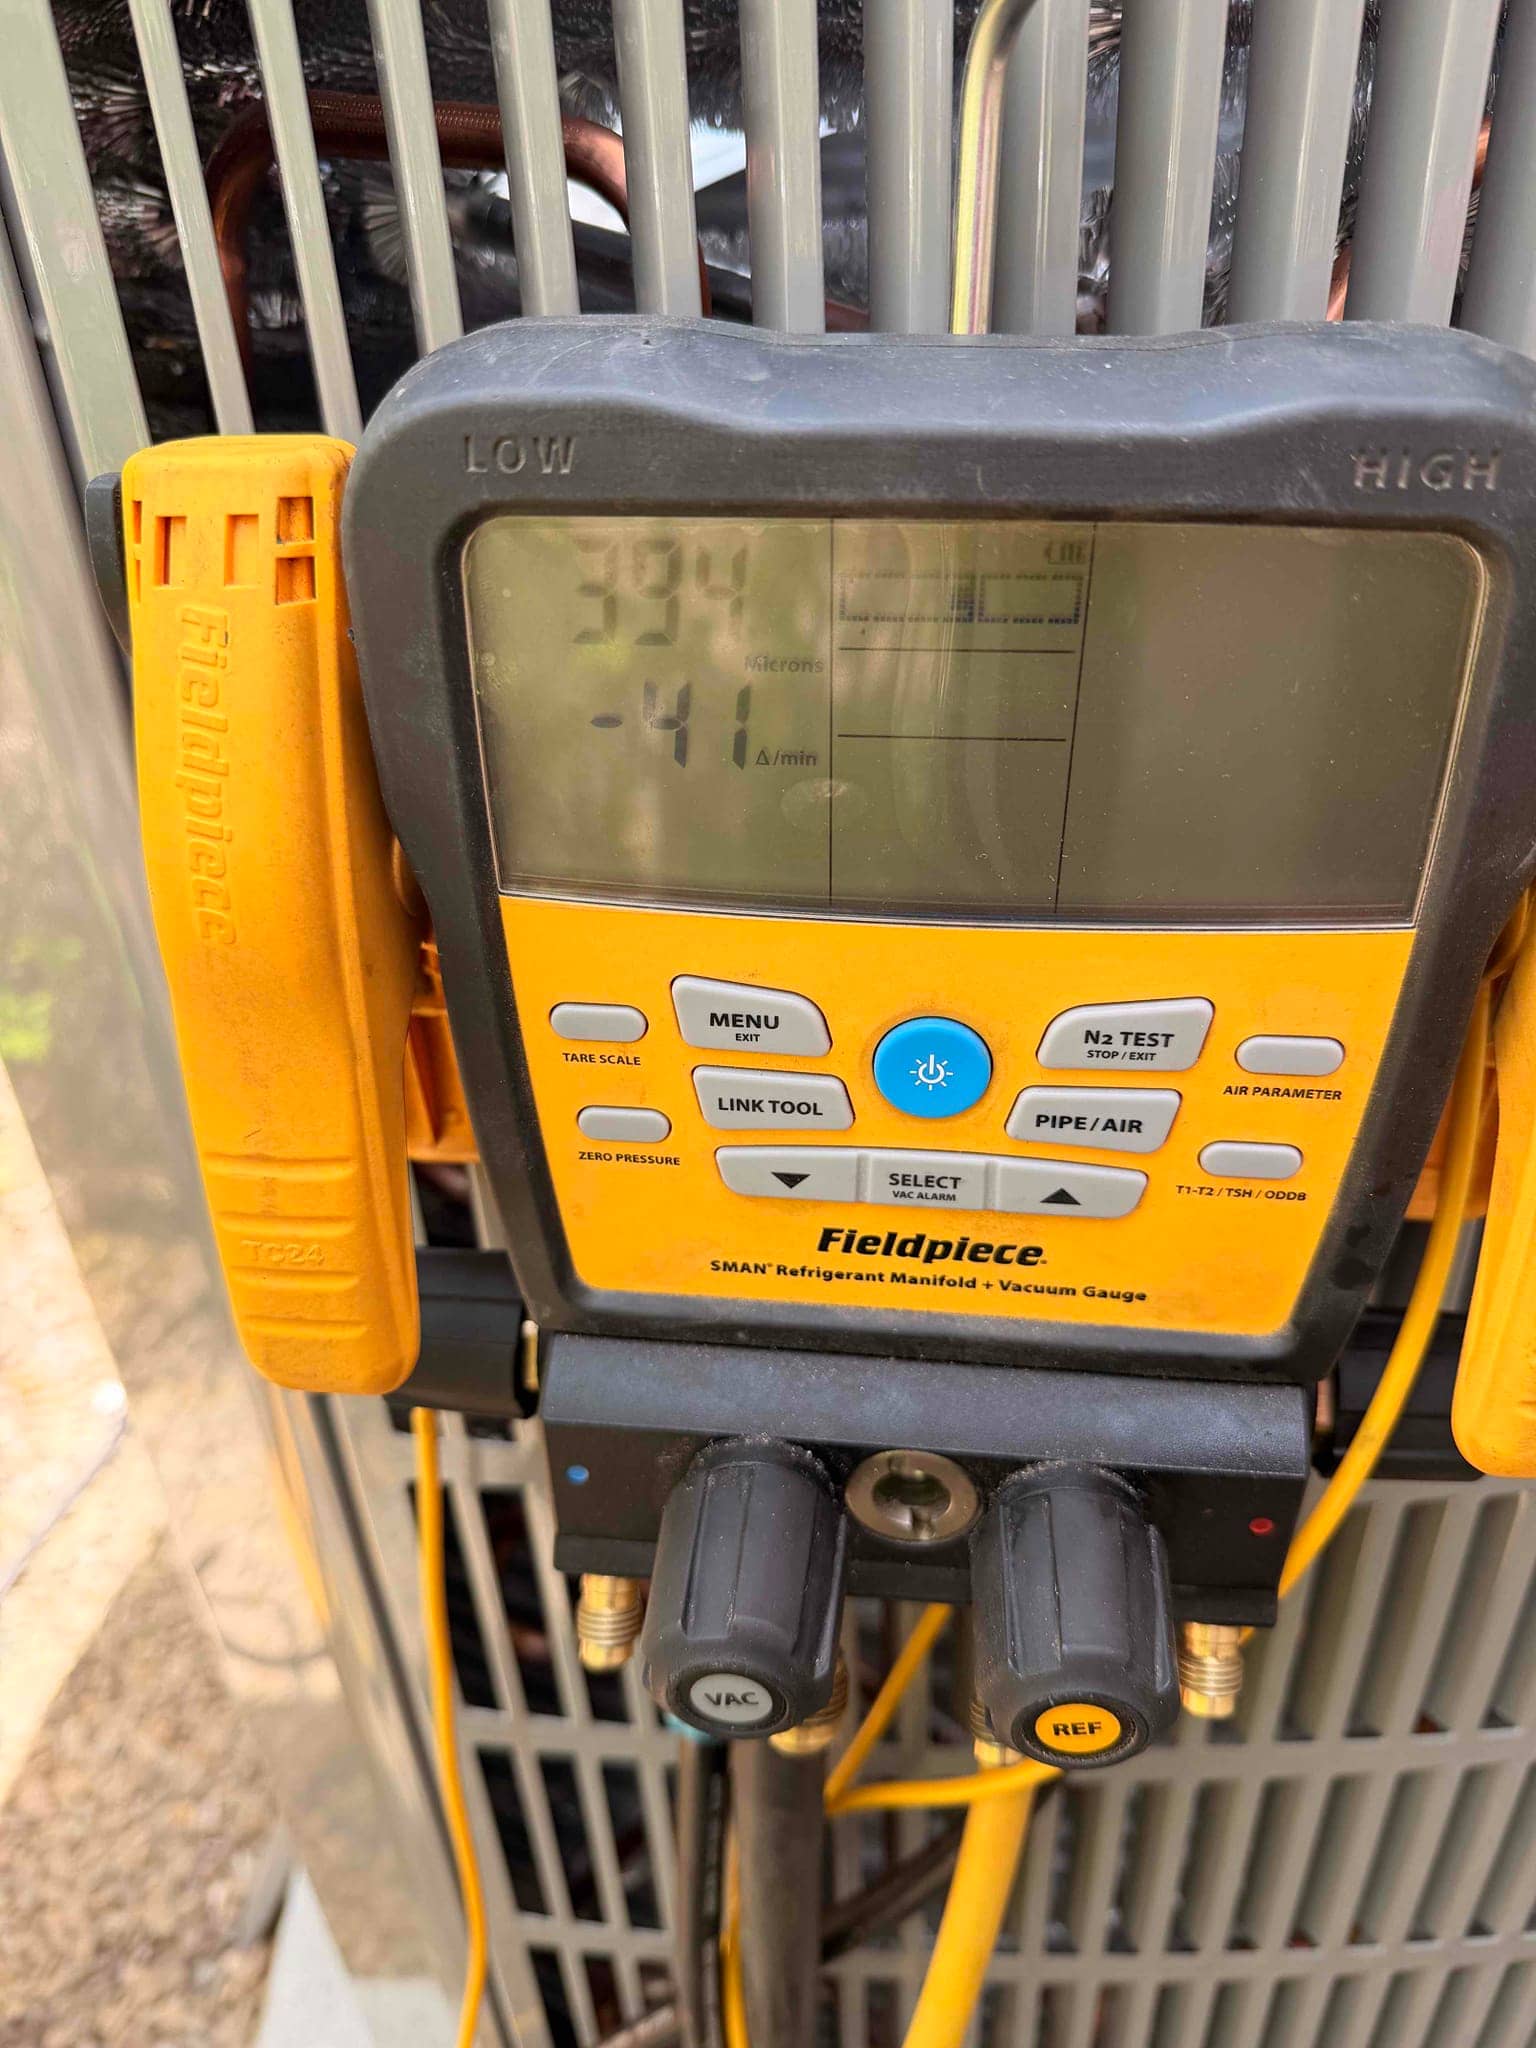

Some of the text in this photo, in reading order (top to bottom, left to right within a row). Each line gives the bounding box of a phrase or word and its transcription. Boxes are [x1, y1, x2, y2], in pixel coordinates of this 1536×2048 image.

[464, 433, 576, 475] LOW
[1352, 448, 1502, 491] HIGH
[573, 538, 747, 646] 394
[744, 655, 824, 673] Microns
[709, 1012, 780, 1030] MENU
[735, 1033, 761, 1043] EXIT
[1120, 1031, 1175, 1048] TEST
[562, 1052, 641, 1066] TARE SCALE
[1087, 1049, 1119, 1060] STOP
[1129, 1051, 1156, 1062] EXIT
[1223, 1085, 1342, 1100] AIR PARAMETER
[717, 1097, 823, 1116] LINK TOOL
[578, 1151, 681, 1166] ZERO PRESSURE
[888, 1172, 961, 1190] SELECT
[892, 1190, 957, 1202] VAC ALARM
[1176, 1185, 1214, 1197] T1-T2
[1225, 1188, 1253, 1198] TSH
[1265, 1190, 1307, 1201] ODDB
[776, 1264, 885, 1283] Refrigerant
[890, 1271, 977, 1290] Manifold
[999, 1280, 1077, 1297] Vacuum
[1083, 1285, 1148, 1302] Gauge
[704, 1691, 759, 1707] VAC
[1052, 1722, 1102, 1737] REF
